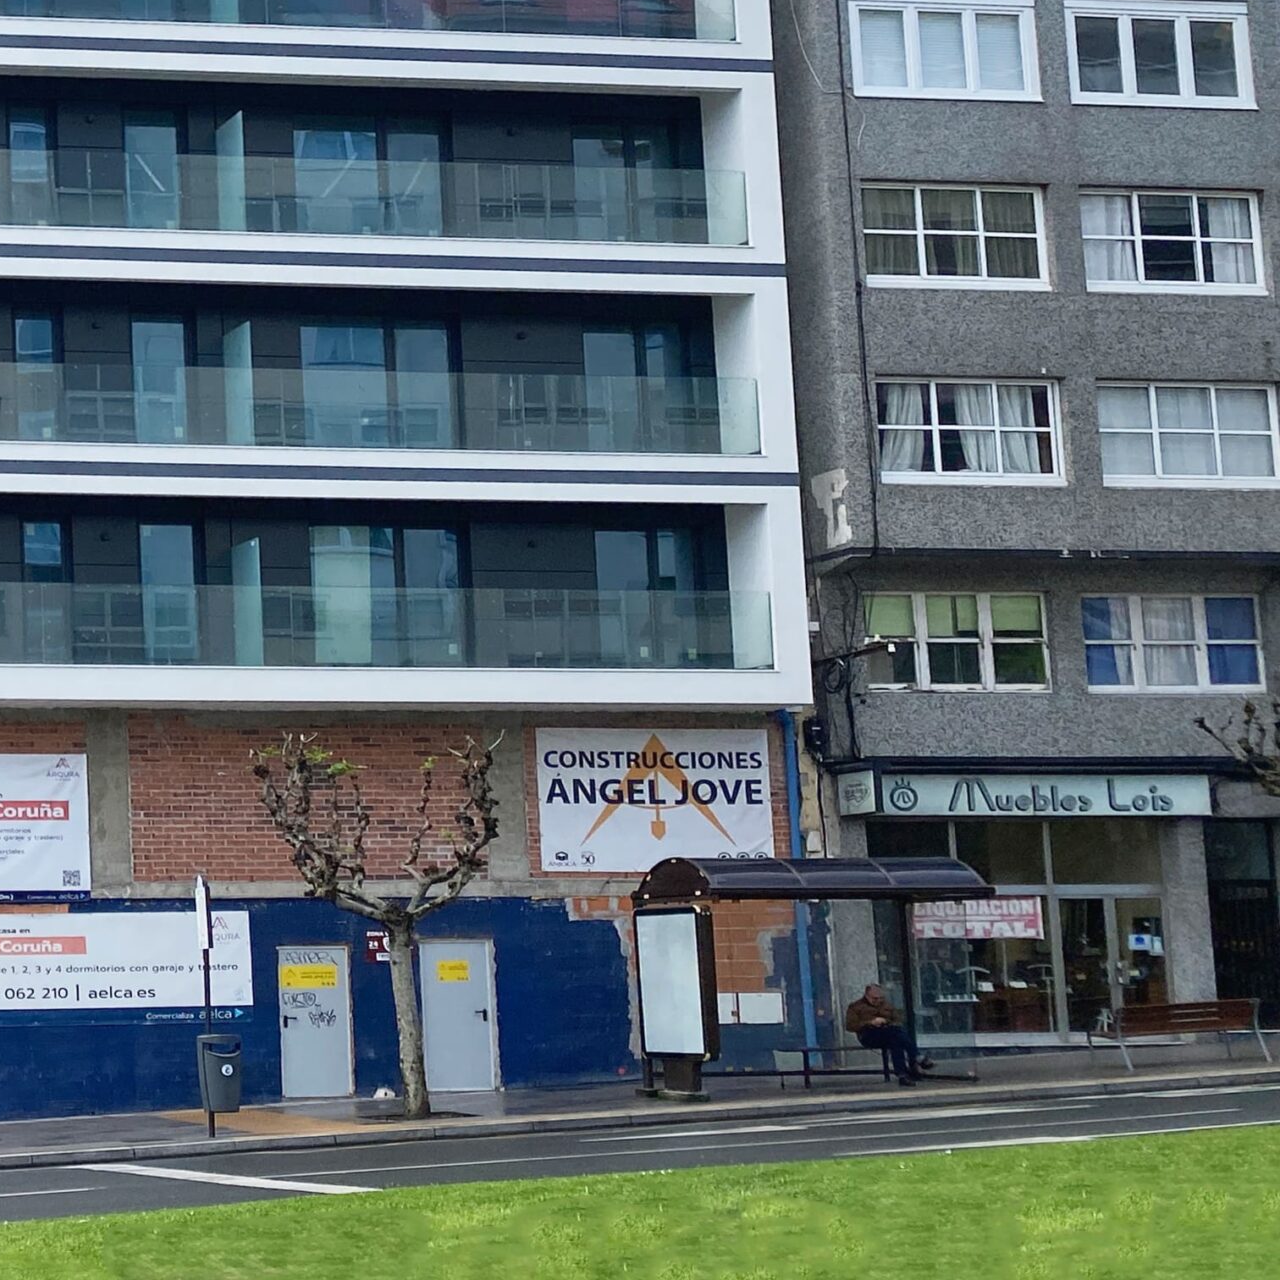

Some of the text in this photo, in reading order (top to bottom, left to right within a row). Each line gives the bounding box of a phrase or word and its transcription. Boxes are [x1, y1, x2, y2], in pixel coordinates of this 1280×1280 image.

[543, 750, 763, 769] CONSTRUCCIONES
[546, 773, 764, 805] ÁNGEL JOVE
[949, 777, 1174, 812] Muebles Lois
[19, 927, 31, 935] en
[915, 920, 1037, 939] TOTAL
[0, 939, 63, 954] Coruña
[35, 965, 42, 974] 3
[45, 966, 52, 975] y
[55, 964, 62, 974] 4
[66, 963, 126, 974] dormitorios
[130, 965, 148, 973] con
[152, 964, 185, 975] garaje
[189, 964, 194, 973] y
[4, 987, 36, 1001] 062
[42, 986, 69, 1000] 210
[145, 1011, 194, 1020] Comercializa
